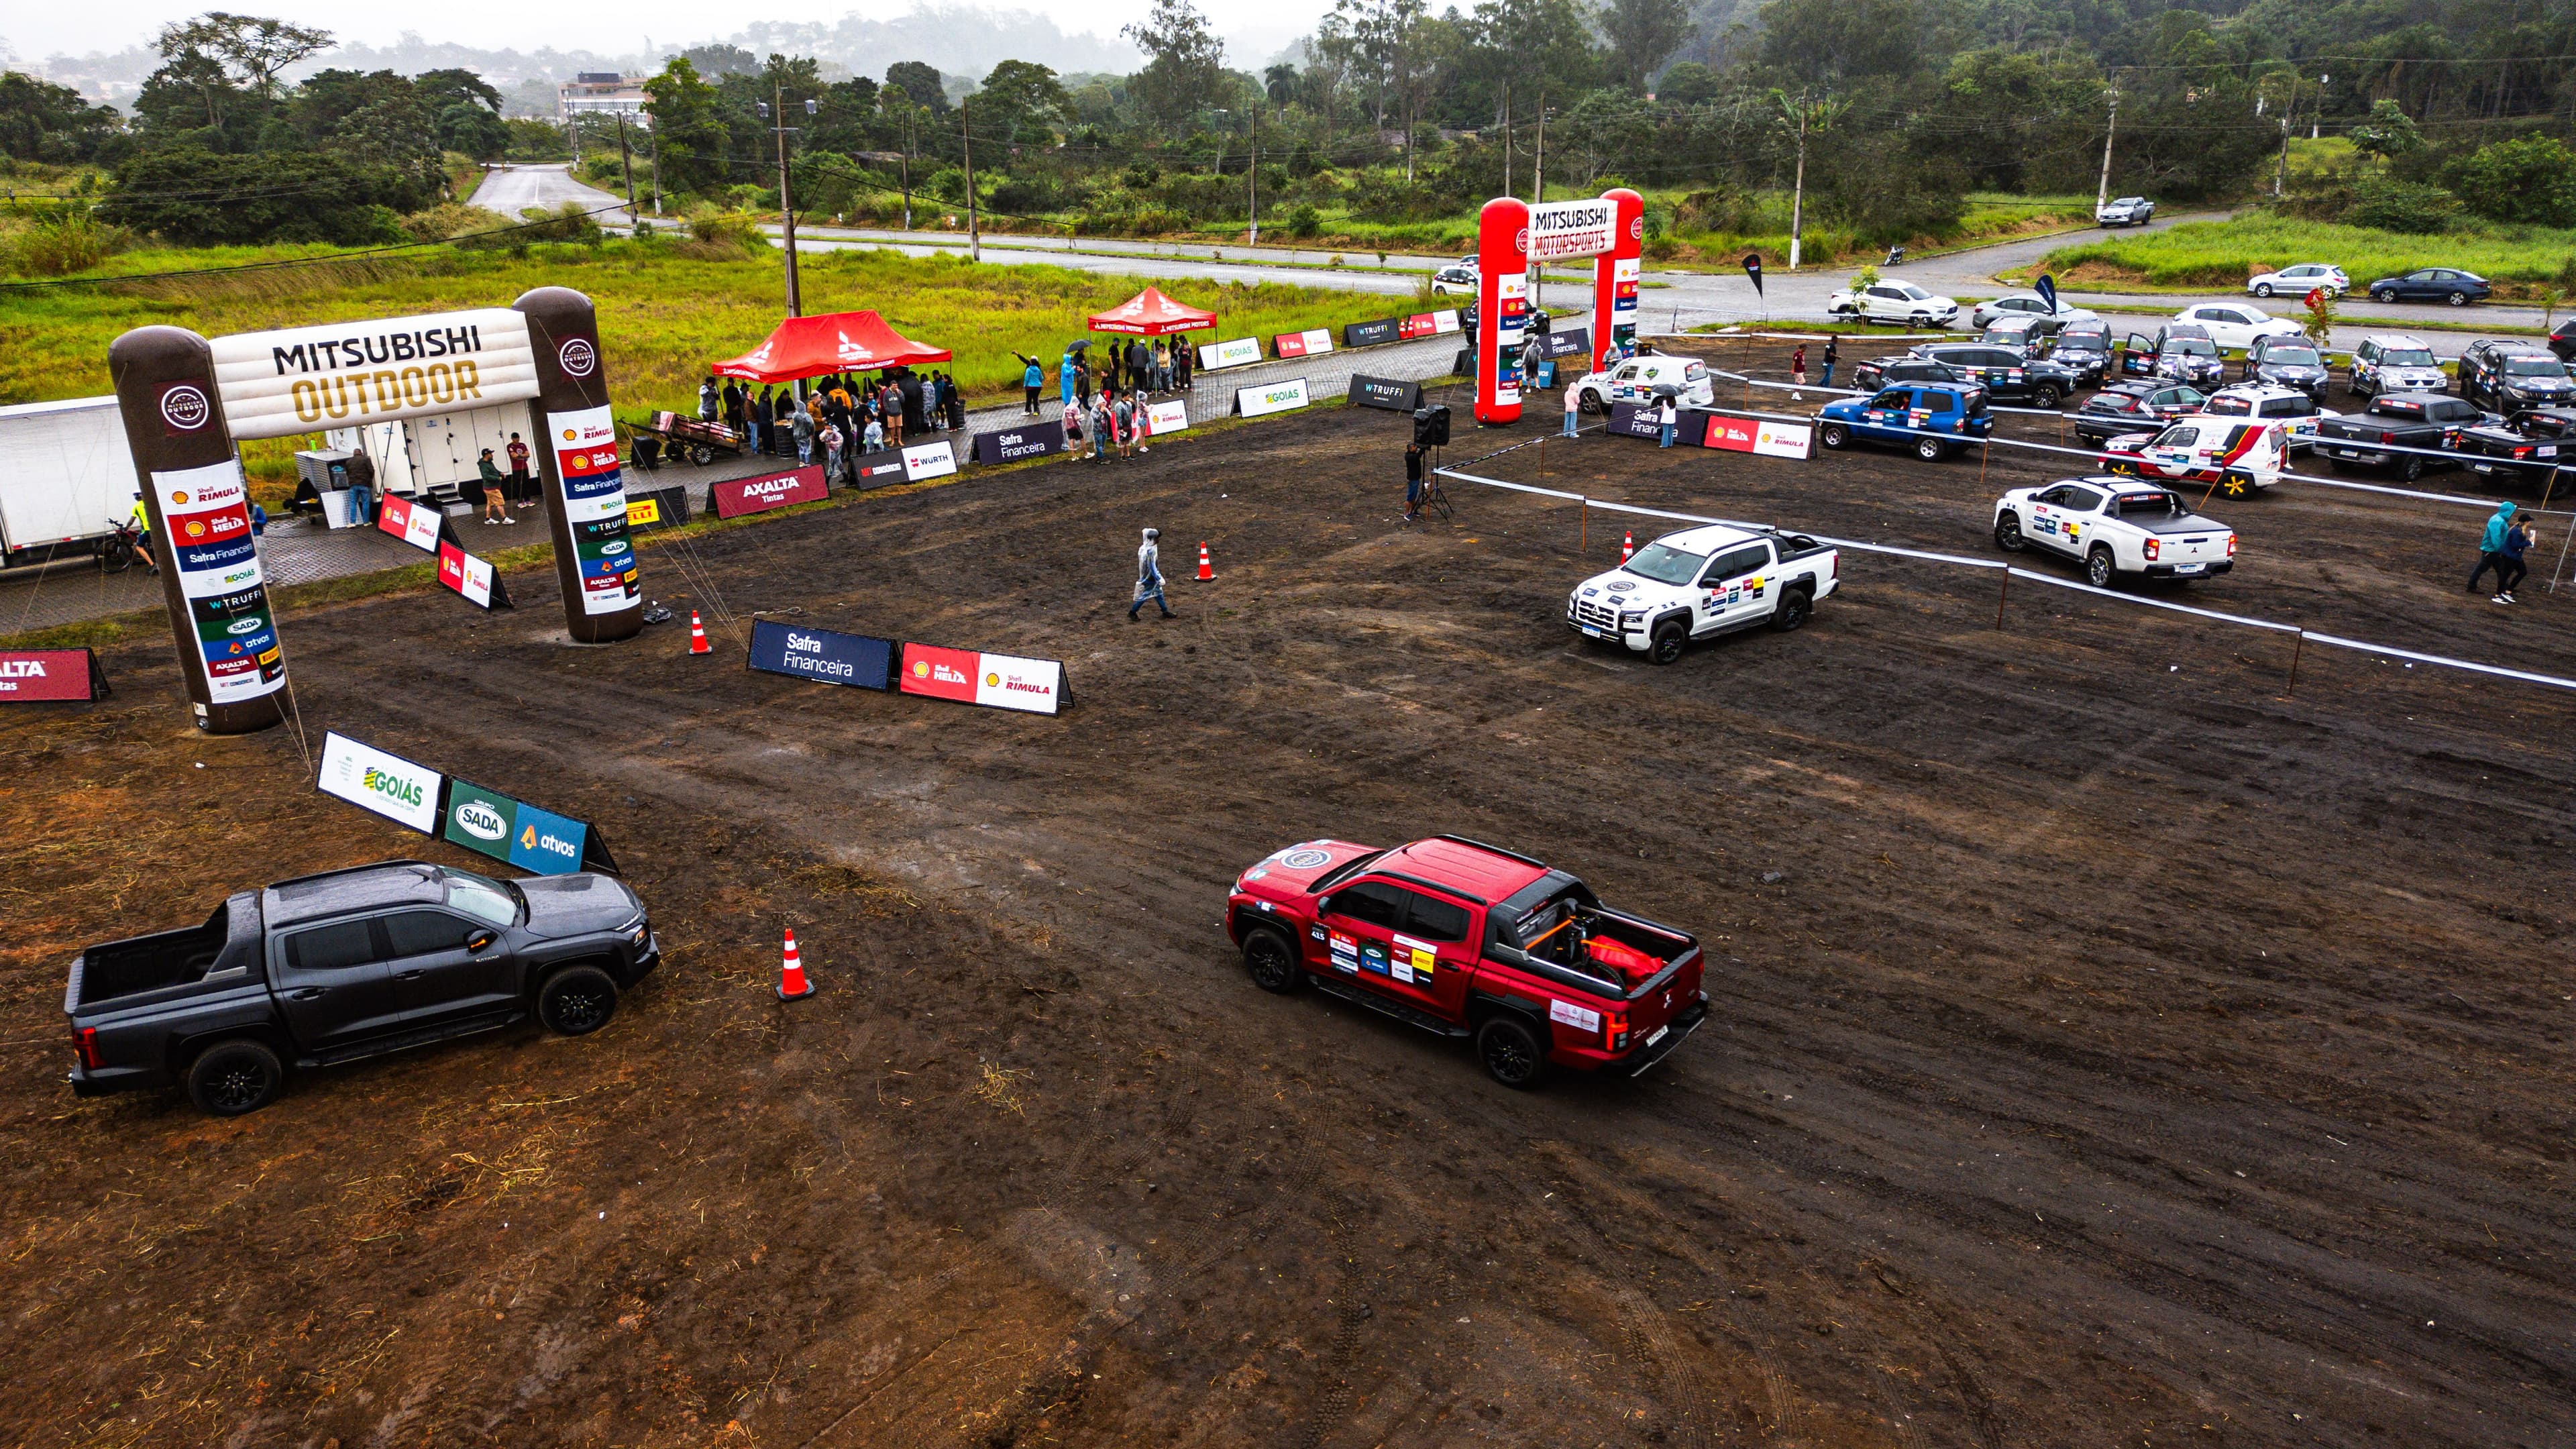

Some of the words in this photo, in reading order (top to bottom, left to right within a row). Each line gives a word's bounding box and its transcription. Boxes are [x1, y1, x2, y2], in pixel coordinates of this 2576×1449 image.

[1536, 207, 1607, 231] MITSUBISHI
[1535, 230, 1606, 256] MOTORSPORTS
[1167, 323, 1191, 331] MITSUBISHI
[272, 325, 481, 375] MITSUBISHI
[291, 360, 482, 423] OUTDOOR
[1272, 387, 1299, 402] GOIÁS
[168, 404, 203, 413] OUTDOOR
[1163, 414, 1183, 422] RIMULA
[1634, 410, 1658, 423] Safra
[1000, 435, 1022, 446] Safra
[1001, 441, 1045, 458] Financeira
[574, 483, 596, 492] Safra
[743, 476, 800, 497] AXALTA
[199, 486, 239, 502] RIMULA
[762, 494, 784, 503] Tintas
[211, 517, 227, 525] Shell
[211, 517, 245, 533] HELIX
[605, 543, 625, 552] SADA
[189, 553, 216, 563] Safra
[231, 568, 255, 581] GOIÁS
[590, 577, 617, 585] AXALTA
[233, 620, 258, 632] SADA
[246, 634, 269, 648] atvos
[787, 633, 821, 653] Safra
[215, 659, 250, 670] AXALTA
[784, 652, 853, 677] Financeira
[934, 671, 967, 684] HELIX
[1006, 682, 1050, 695] RIMULA
[374, 771, 423, 806] GOIÁS
[474, 799, 494, 810] GRUPO
[463, 808, 498, 834] SADA
[541, 835, 575, 857] atvos
[1311, 930, 1325, 941] 415
